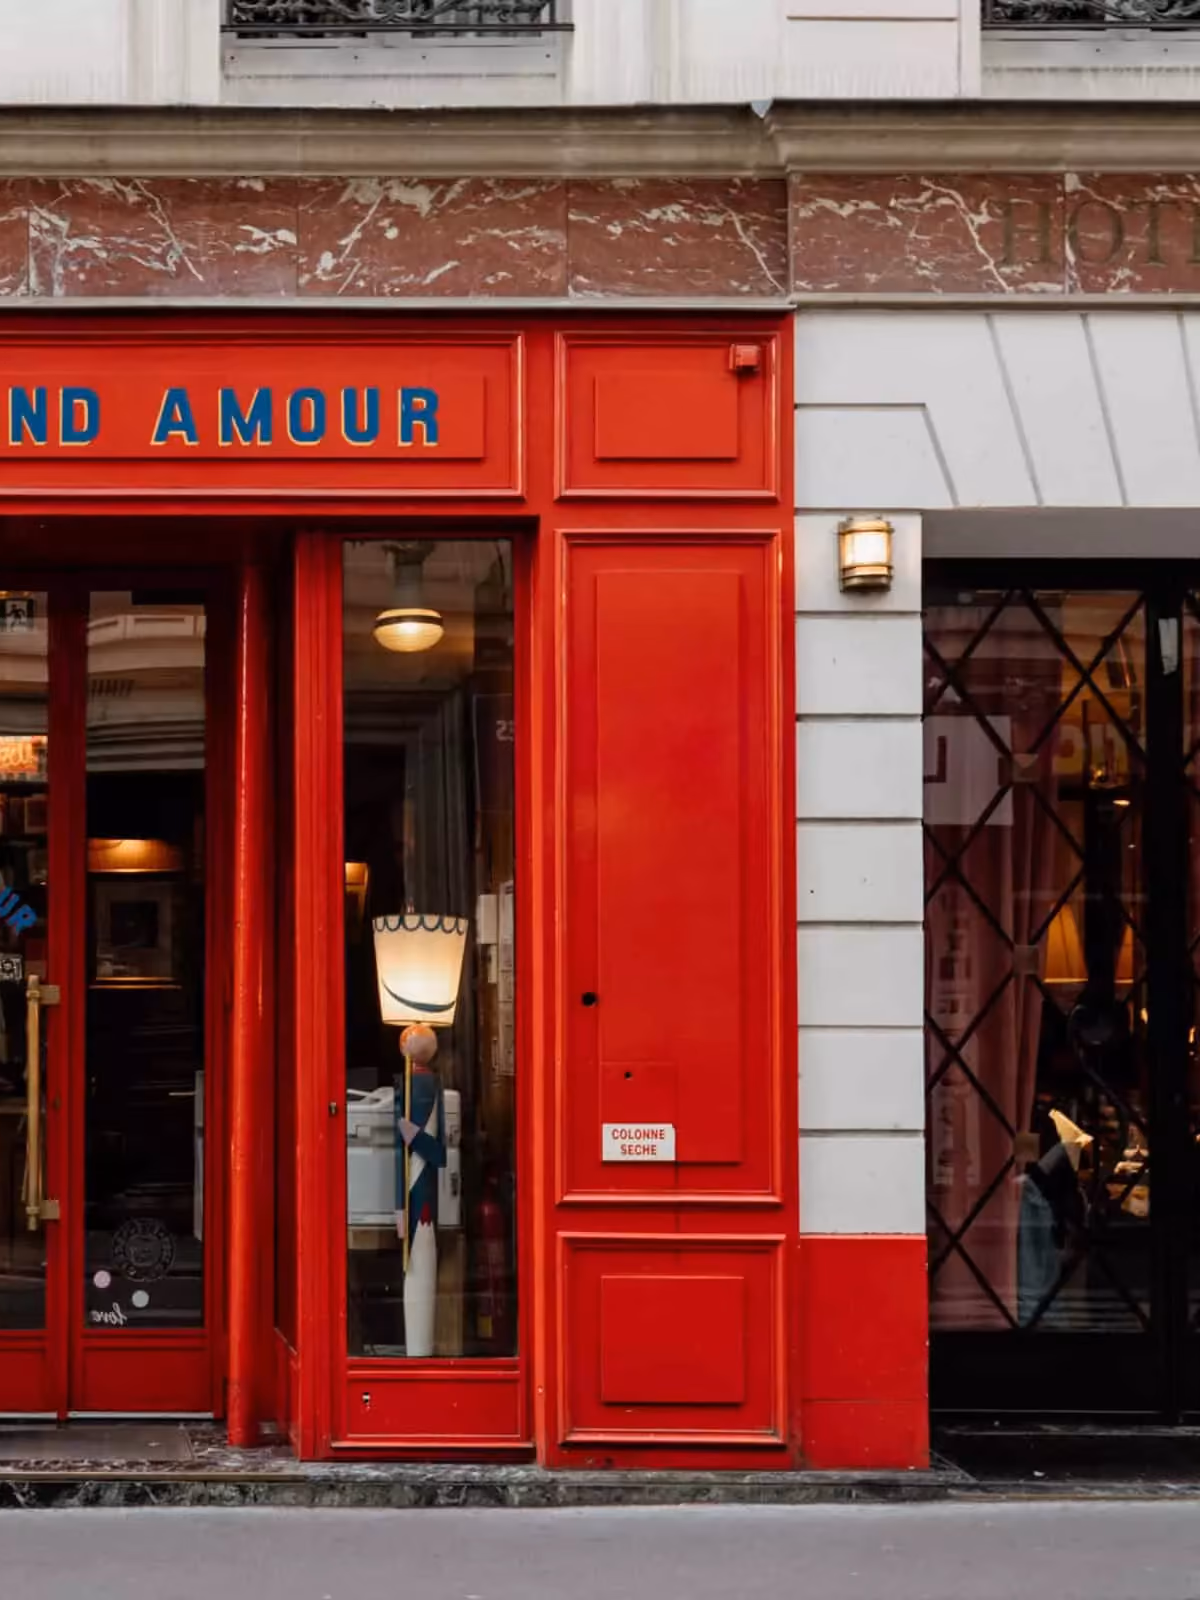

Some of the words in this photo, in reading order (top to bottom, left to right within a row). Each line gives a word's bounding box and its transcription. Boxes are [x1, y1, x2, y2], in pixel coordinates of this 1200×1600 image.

[149, 387, 440, 447] AMOUR
[611, 1128, 665, 1140] COLONNE
[620, 1143, 657, 1156] SECHE
